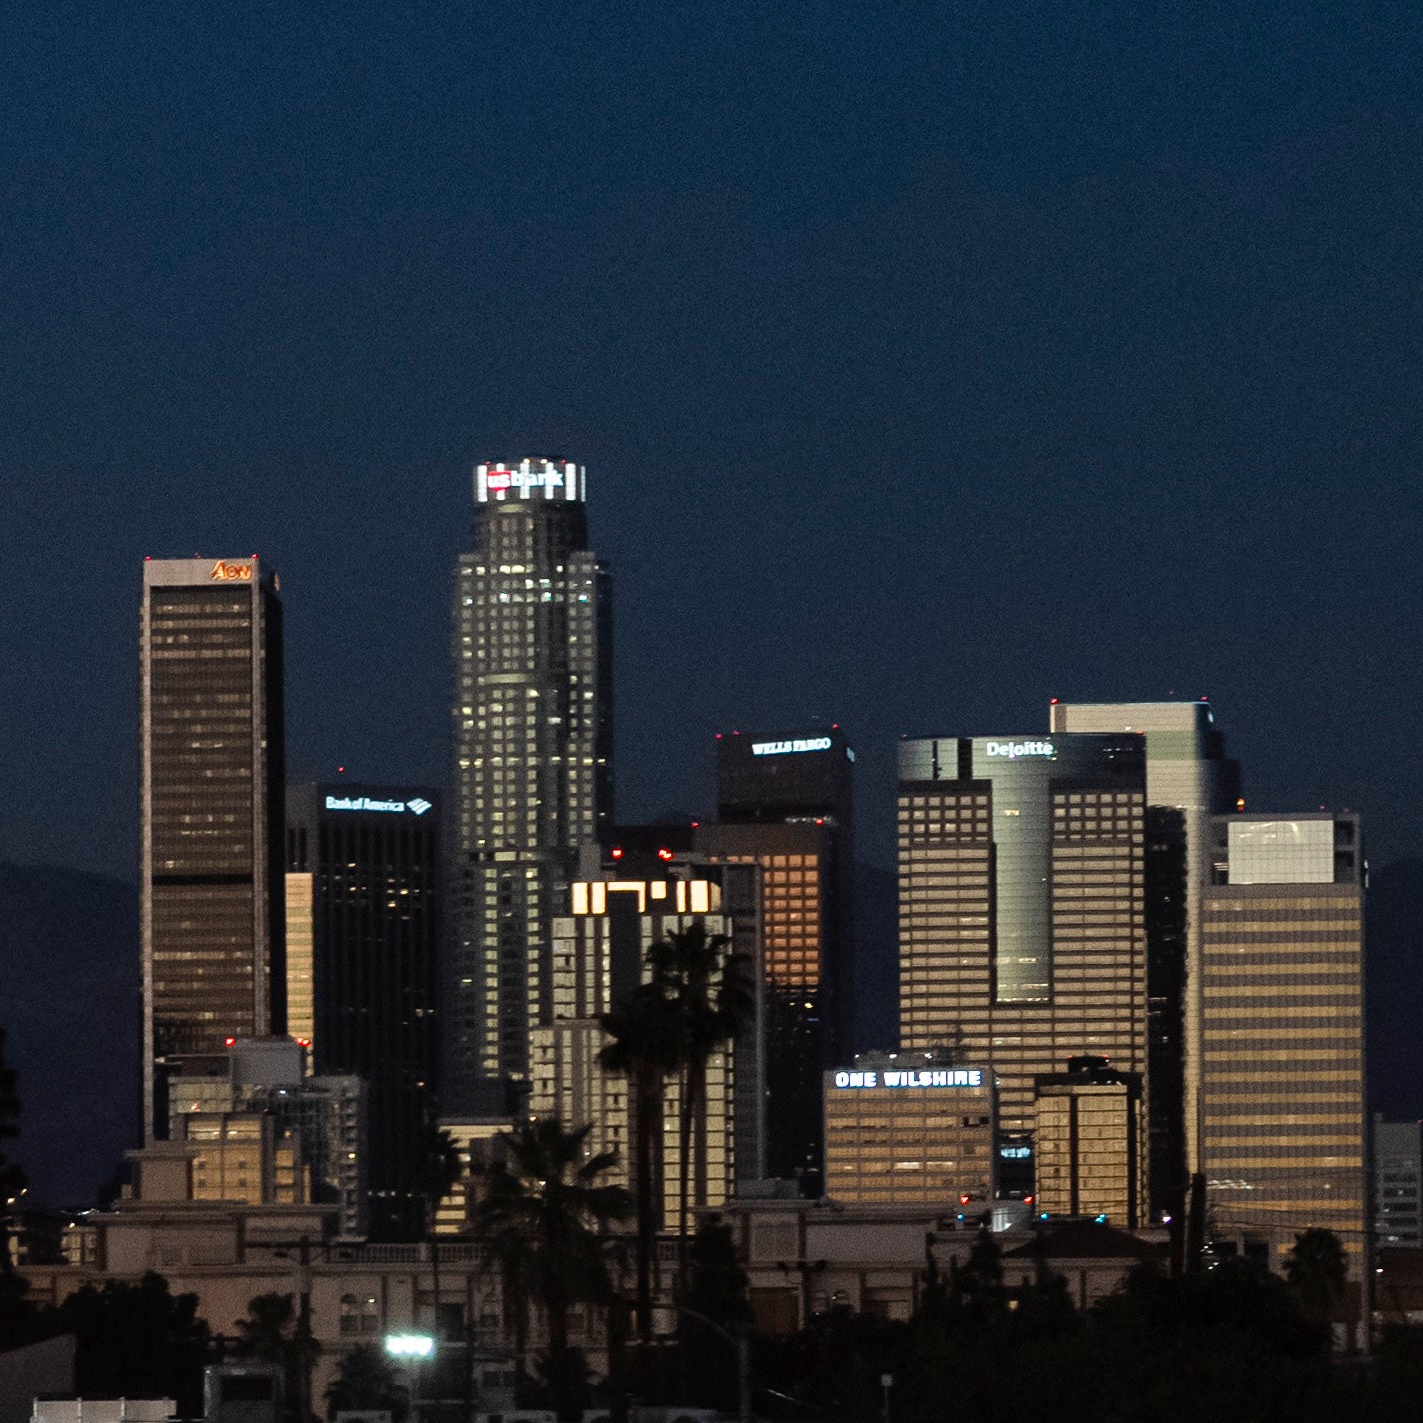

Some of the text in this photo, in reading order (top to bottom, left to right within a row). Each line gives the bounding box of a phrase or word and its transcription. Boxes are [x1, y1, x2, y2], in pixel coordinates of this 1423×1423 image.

[751, 737, 832, 755] WELLS FARGO
[325, 796, 352, 809] Bank
[364, 797, 405, 812] America
[835, 1070, 981, 1088] ONE WILSHIRE
